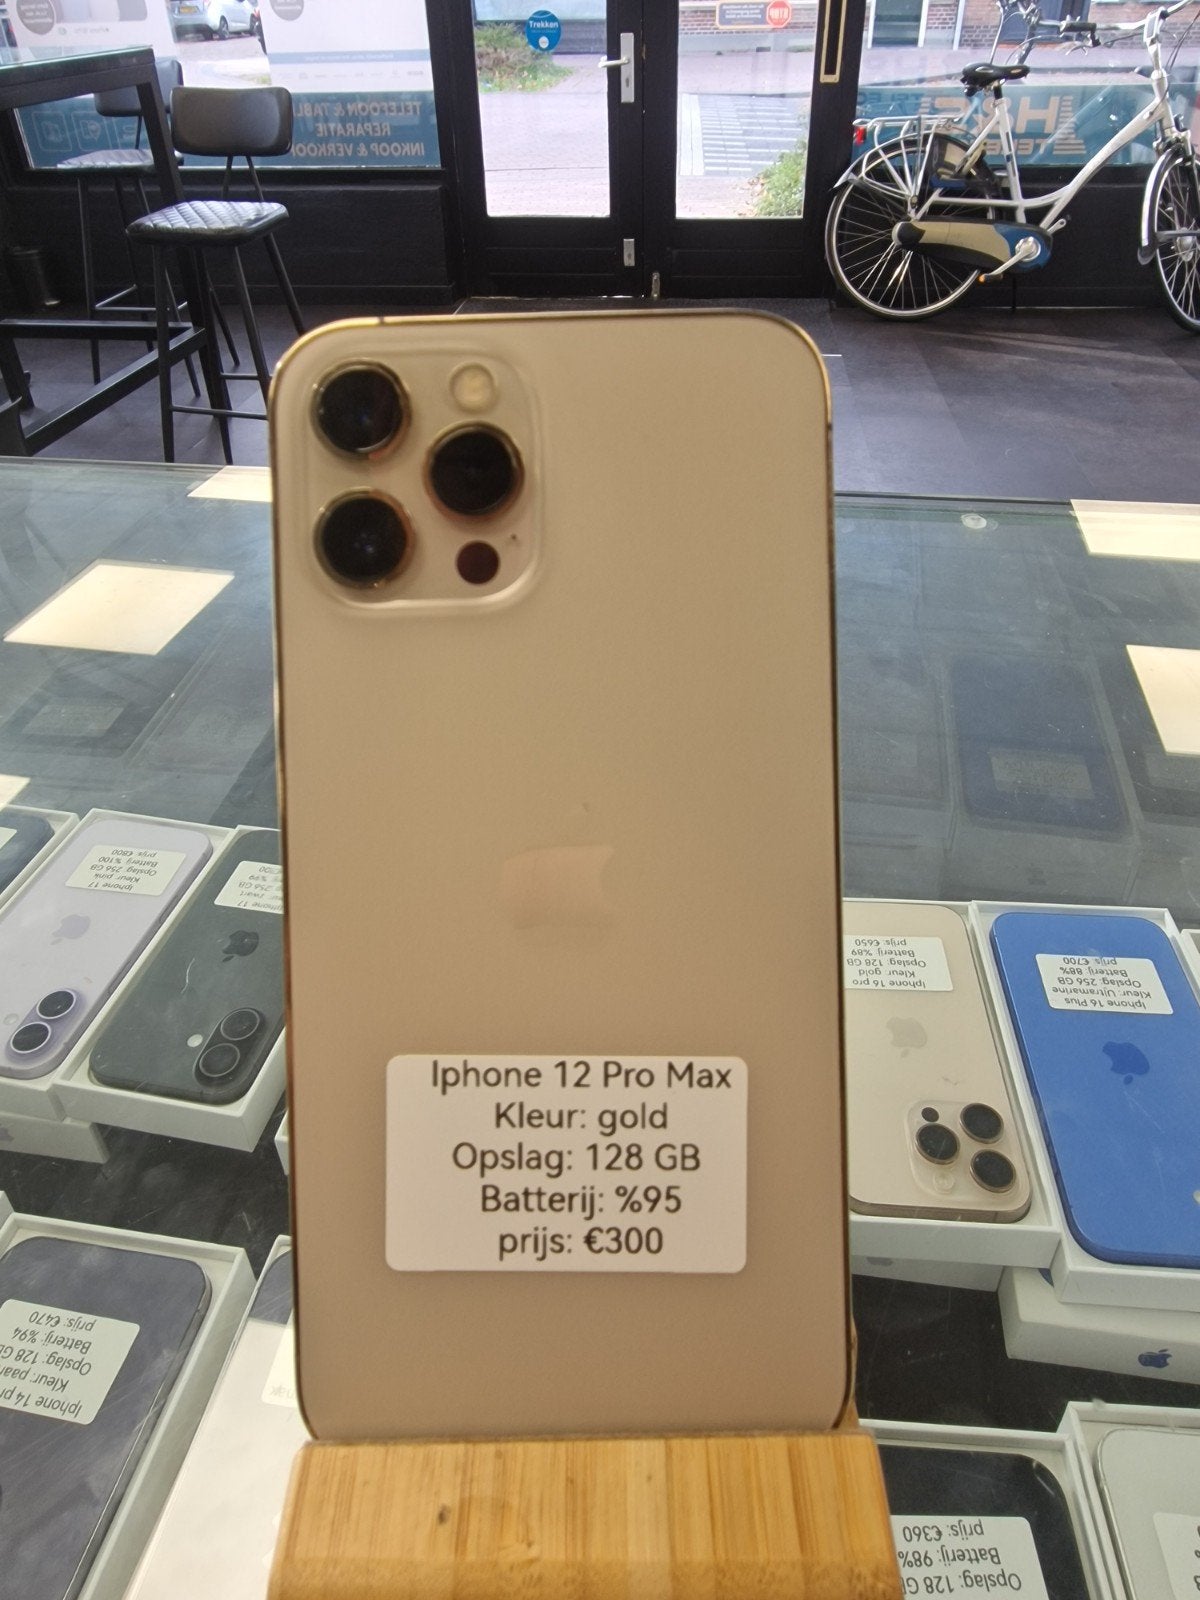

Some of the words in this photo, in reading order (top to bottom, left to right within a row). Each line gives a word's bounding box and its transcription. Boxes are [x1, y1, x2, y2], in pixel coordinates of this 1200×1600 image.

[855, 938, 880, 947] €650
[846, 958, 862, 966] GB
[864, 958, 884, 967] 128
[1062, 957, 1090, 966] €700
[858, 967, 882, 977] gold
[1059, 966, 1083, 975] 88%
[873, 979, 886, 987] 16
[889, 979, 926, 989] Iphone
[1057, 977, 1074, 985] GB
[1076, 977, 1097, 986] 256
[1065, 997, 1088, 1007] Plus
[1089, 998, 1104, 1007] 16
[1108, 1000, 1147, 1010] Iphone
[432, 1059, 542, 1096] Iphone
[554, 1060, 591, 1088] 12
[603, 1060, 655, 1089] Pro
[667, 1060, 732, 1089] Max
[494, 1101, 586, 1129] Kleur:
[597, 1101, 668, 1137] gold
[452, 1141, 573, 1178] Opslag:
[586, 1142, 643, 1171] 128
[654, 1142, 701, 1171] GB
[480, 1184, 604, 1221] Batterij:
[614, 1184, 682, 1214] %95
[499, 1226, 572, 1261] prijs:
[583, 1226, 664, 1255] €300
[28, 1311, 61, 1328] €470
[63, 1316, 97, 1332] prijs:
[11, 1327, 40, 1344] %94
[41, 1331, 92, 1355] Batterij:
[14, 1349, 39, 1365] 128
[42, 1351, 92, 1376] Opslag:
[30, 1372, 70, 1393] Kleur:
[14, 1392, 31, 1407] 14
[35, 1396, 82, 1418] Iphone
[902, 1525, 943, 1542] €360
[946, 1518, 984, 1541] prijs:
[897, 1550, 933, 1568] 98%
[936, 1544, 1001, 1567] Batterij:
[901, 1577, 919, 1595] G
[923, 1575, 954, 1594] 128
[958, 1568, 1022, 1592] Opslag:
